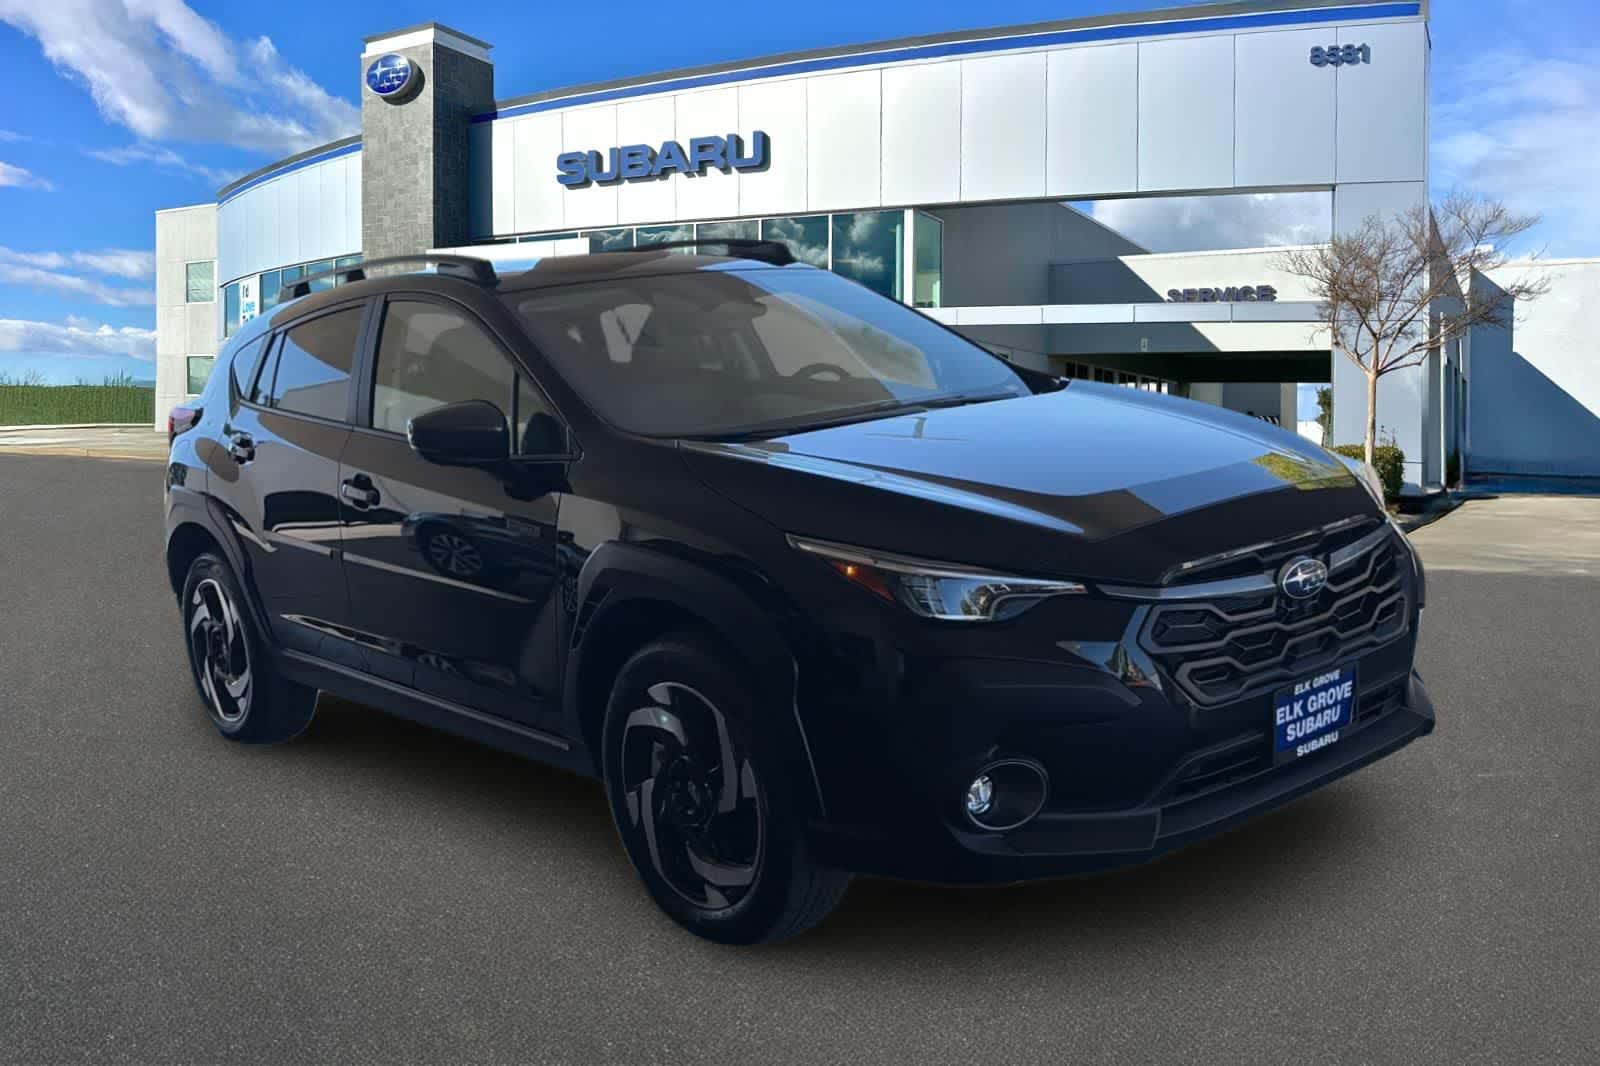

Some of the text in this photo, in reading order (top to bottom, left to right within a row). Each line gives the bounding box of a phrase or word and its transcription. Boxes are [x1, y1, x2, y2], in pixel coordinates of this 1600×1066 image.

[556, 130, 771, 190] SUBARU
[1167, 285, 1277, 302] SERVICE
[1294, 669, 1341, 696] ELK GROVE
[1276, 680, 1353, 726] ELK GROVE
[1286, 703, 1341, 742] SUBARU
[1296, 731, 1339, 757] SUBARU
